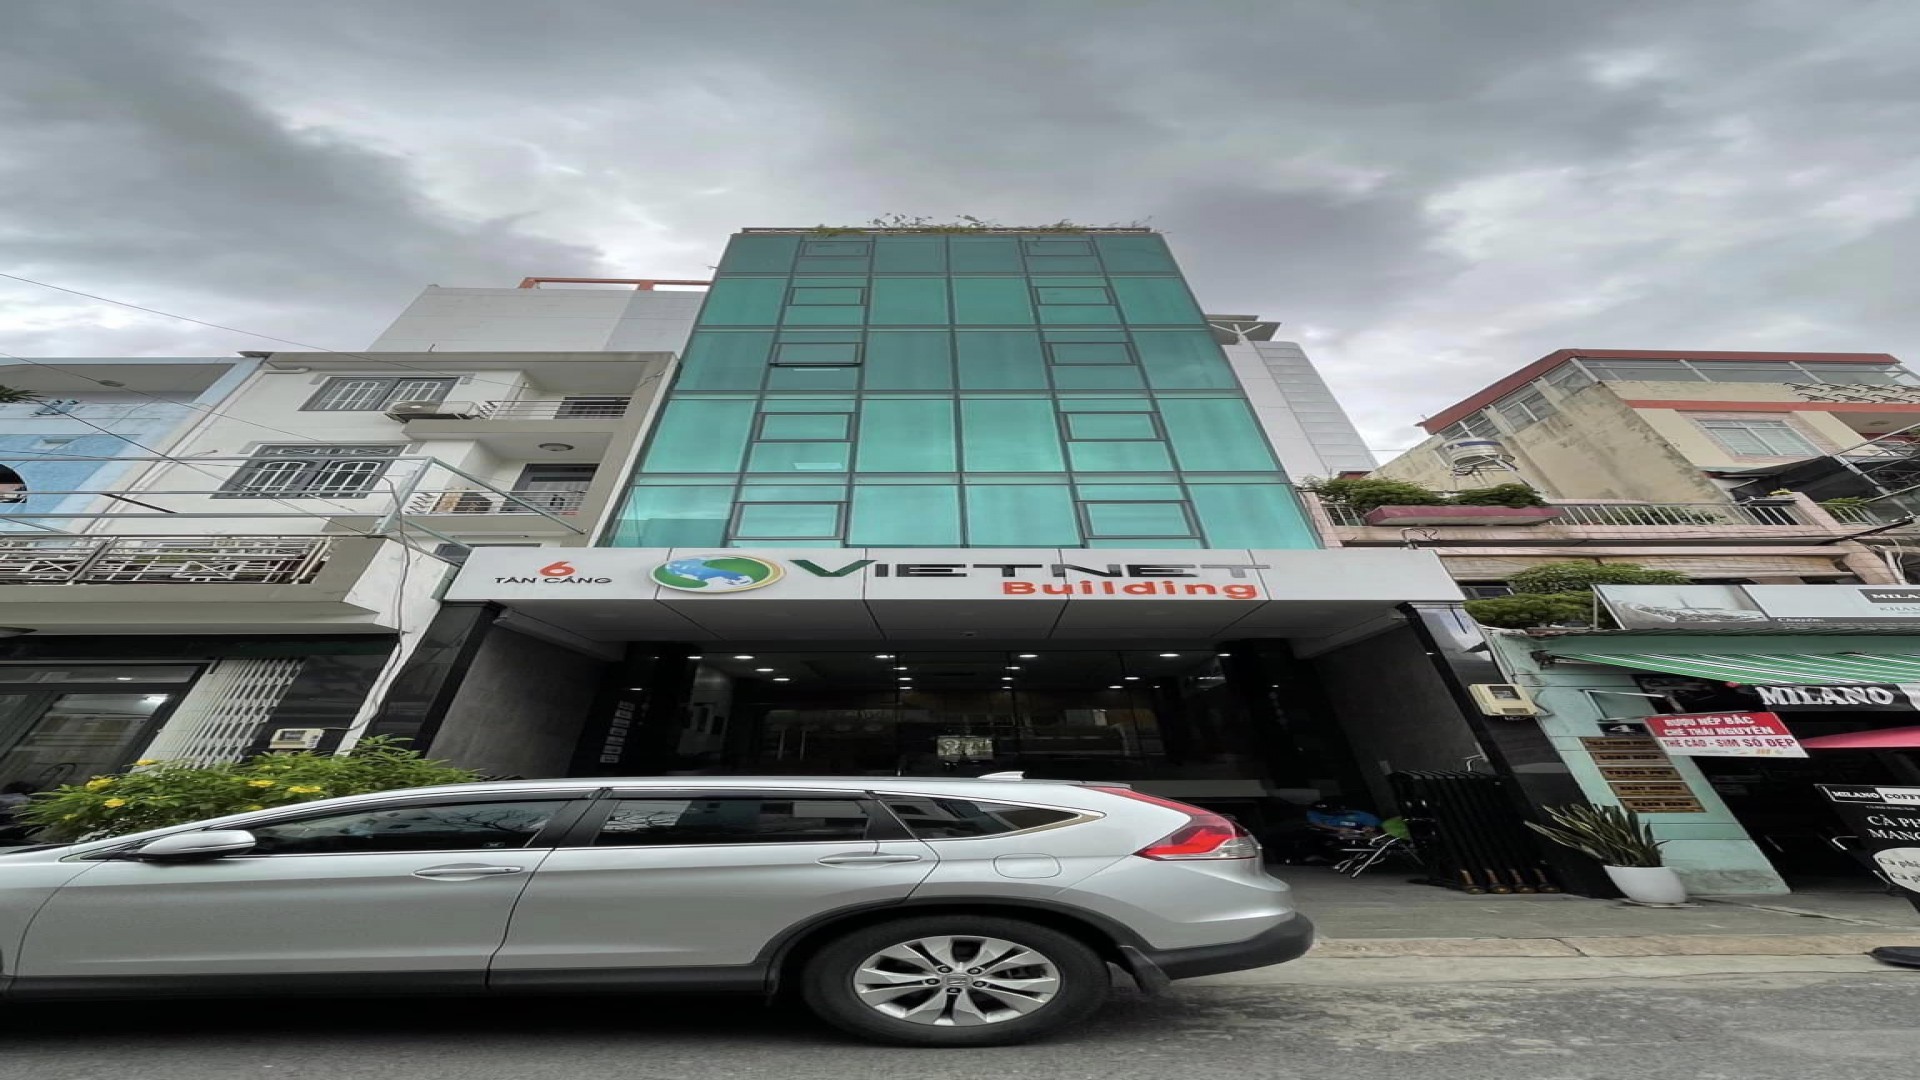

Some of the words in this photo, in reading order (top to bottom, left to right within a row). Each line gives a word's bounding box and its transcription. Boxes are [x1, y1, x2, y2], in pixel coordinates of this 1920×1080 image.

[539, 561, 576, 577] 6
[788, 559, 1271, 578] VIETNET
[1002, 580, 1259, 600] Building
[1755, 686, 1894, 706] MILANO
[1609, 724, 1635, 733] 4
[1866, 814, 1898, 827] CÀ
